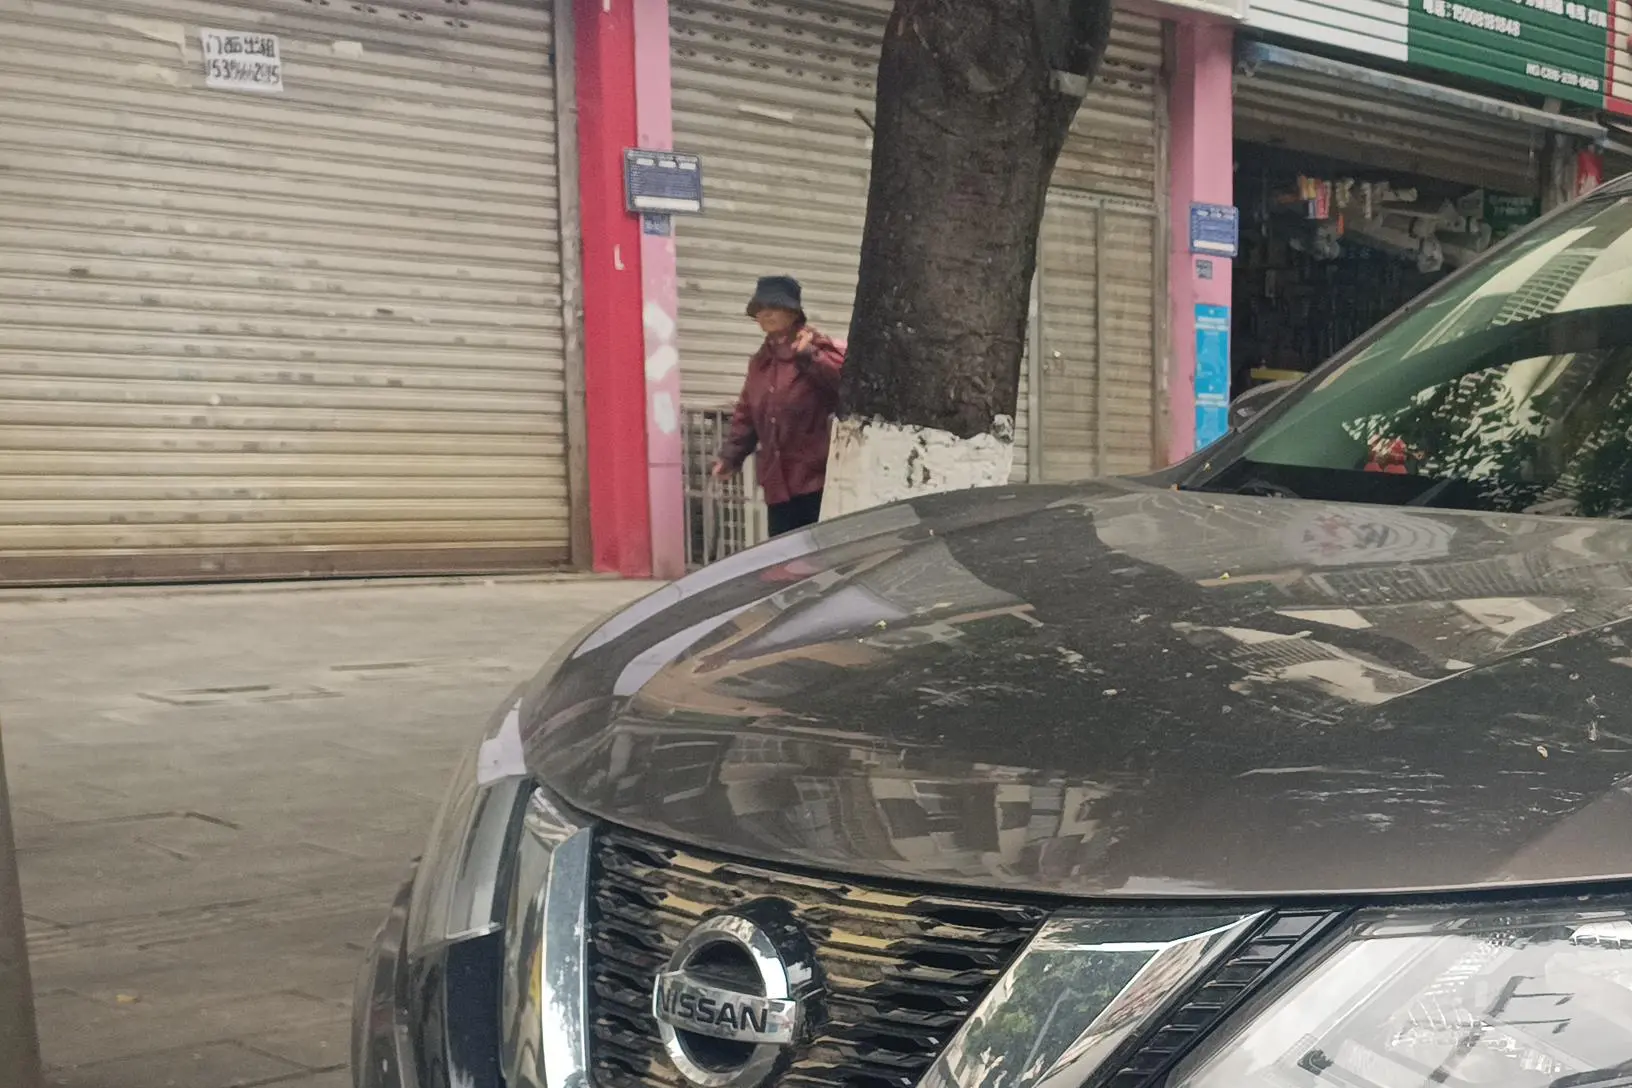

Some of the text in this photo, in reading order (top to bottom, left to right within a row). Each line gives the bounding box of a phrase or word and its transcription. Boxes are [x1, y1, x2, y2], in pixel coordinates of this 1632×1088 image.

[206, 34, 275, 57] 门面出租
[660, 986, 768, 1034] NISSAN
